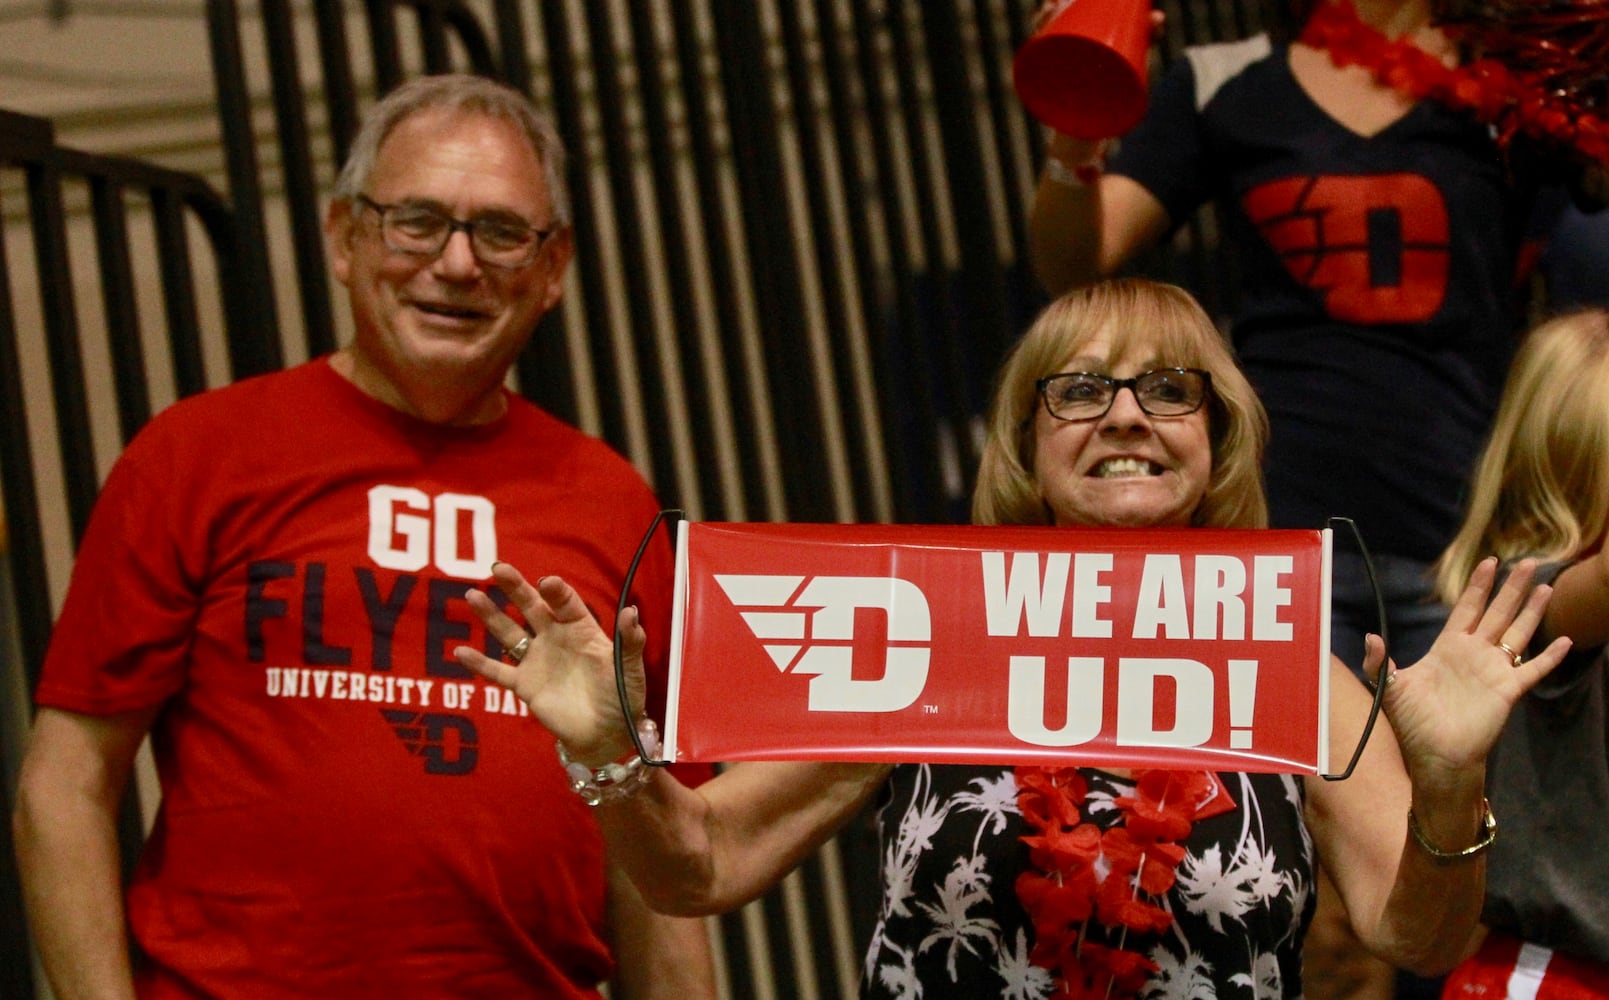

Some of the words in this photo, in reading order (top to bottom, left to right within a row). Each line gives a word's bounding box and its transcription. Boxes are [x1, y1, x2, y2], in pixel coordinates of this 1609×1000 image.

[367, 484, 497, 580] GO
[244, 560, 601, 680] FLYE
[981, 551, 1114, 638] WE
[1131, 554, 1294, 642] ARE
[265, 667, 433, 707] UNIVERSITY
[442, 682, 475, 710] OF
[923, 704, 939, 714] TM
[1007, 655, 1259, 750] UD!
